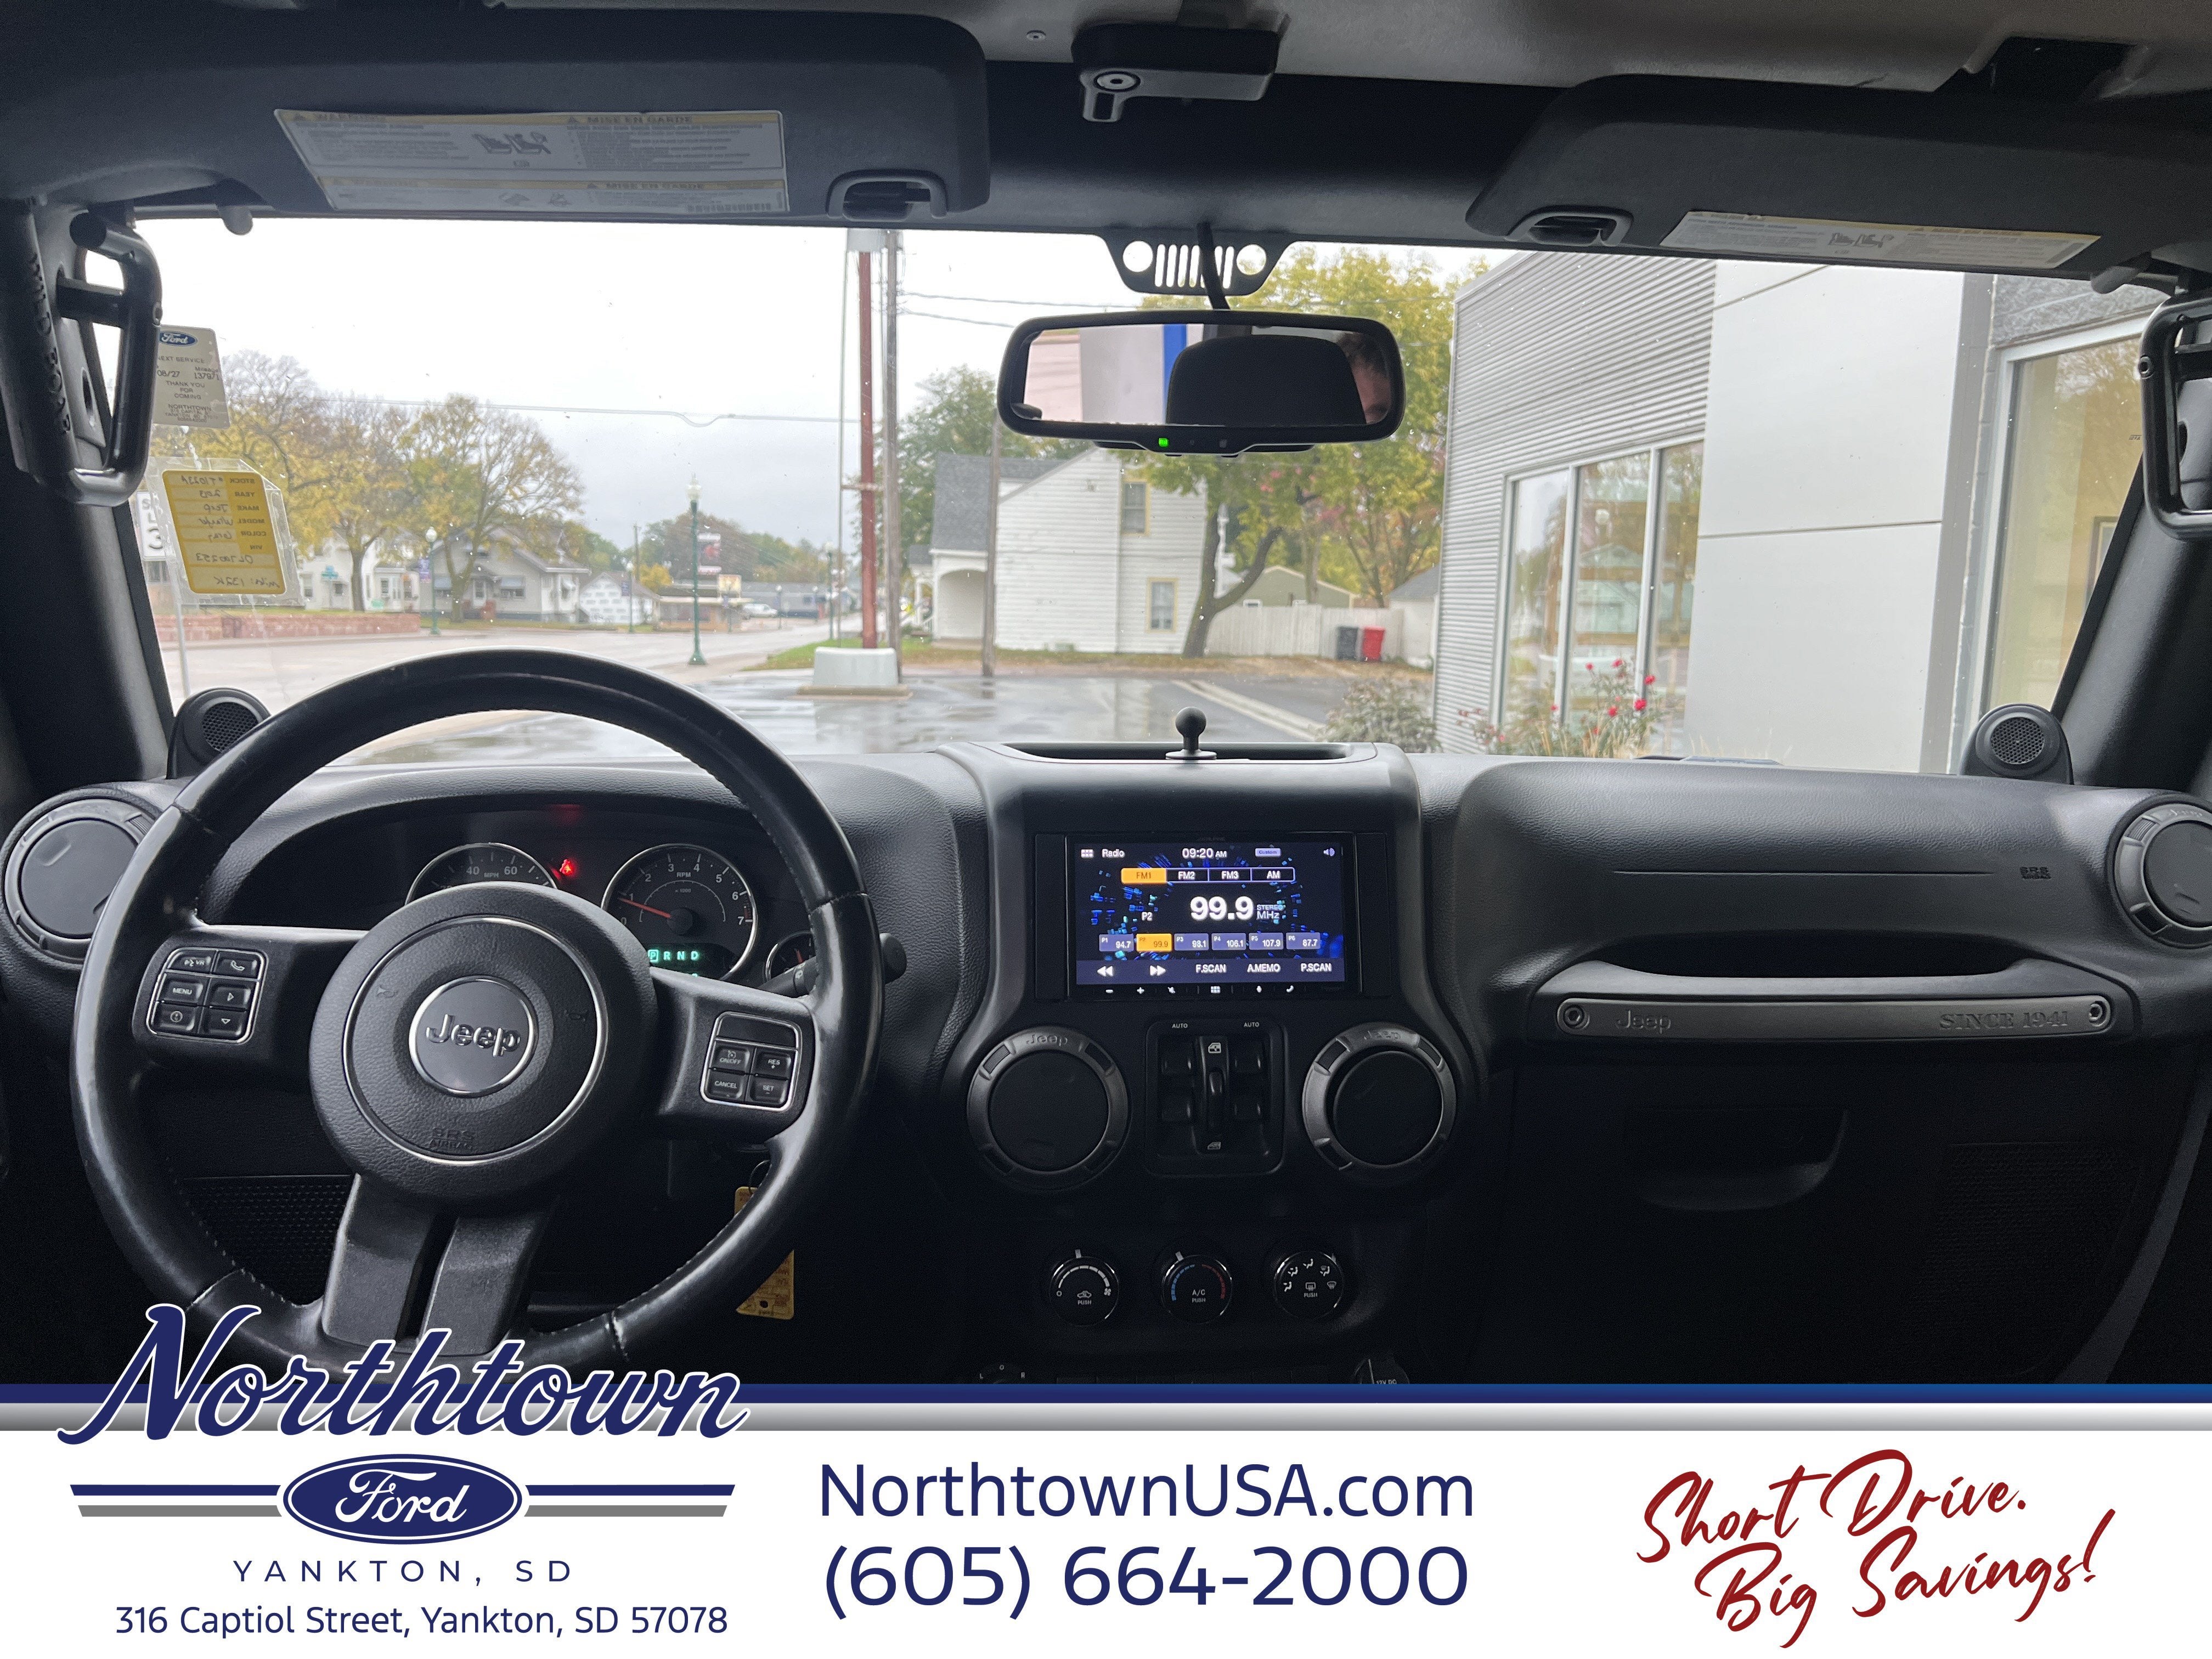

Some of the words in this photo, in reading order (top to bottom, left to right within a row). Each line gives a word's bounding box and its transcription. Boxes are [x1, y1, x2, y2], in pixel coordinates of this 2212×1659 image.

[161, 332, 189, 345] Ford
[1102, 849, 1125, 858] Radio
[1182, 848, 1214, 859] 09:20
[1215, 850, 1227, 858] AM
[466, 866, 480, 877] 40
[504, 865, 518, 876] 60
[668, 862, 675, 873] 3
[693, 862, 701, 873] 4
[645, 873, 652, 882] 2
[715, 874, 723, 884] 5
[1136, 871, 1152, 879] FM1
[1177, 871, 1195, 880] FM2
[1221, 870, 1239, 879] FM3
[1266, 870, 1281, 879] AM
[731, 891, 739, 901] 6
[1189, 895, 1255, 921] 99.9
[1141, 912, 1153, 921] P2
[1256, 910, 1280, 921] MHz
[737, 916, 744, 926] 7
[1115, 940, 1132, 949] 94.7
[1153, 940, 1169, 949] 99.9
[1226, 940, 1244, 948] 106.1
[1262, 939, 1281, 947] 107.9
[1302, 938, 1318, 947] 87.7
[663, 951, 671, 961] R
[677, 951, 685, 961] N
[691, 951, 699, 961] D
[1195, 964, 1227, 974] F.SCAN
[1247, 963, 1281, 973] A.MEMO
[1300, 963, 1333, 972] P.SCAN
[1615, 1010, 1671, 1034] Jeep
[1938, 1012, 2015, 1030] SINCE
[2022, 1011, 2069, 1029] 1941
[426, 1013, 521, 1057] Jeep
[1025, 1034, 1069, 1047] Jeep
[714, 1080, 737, 1089] CANCEL
